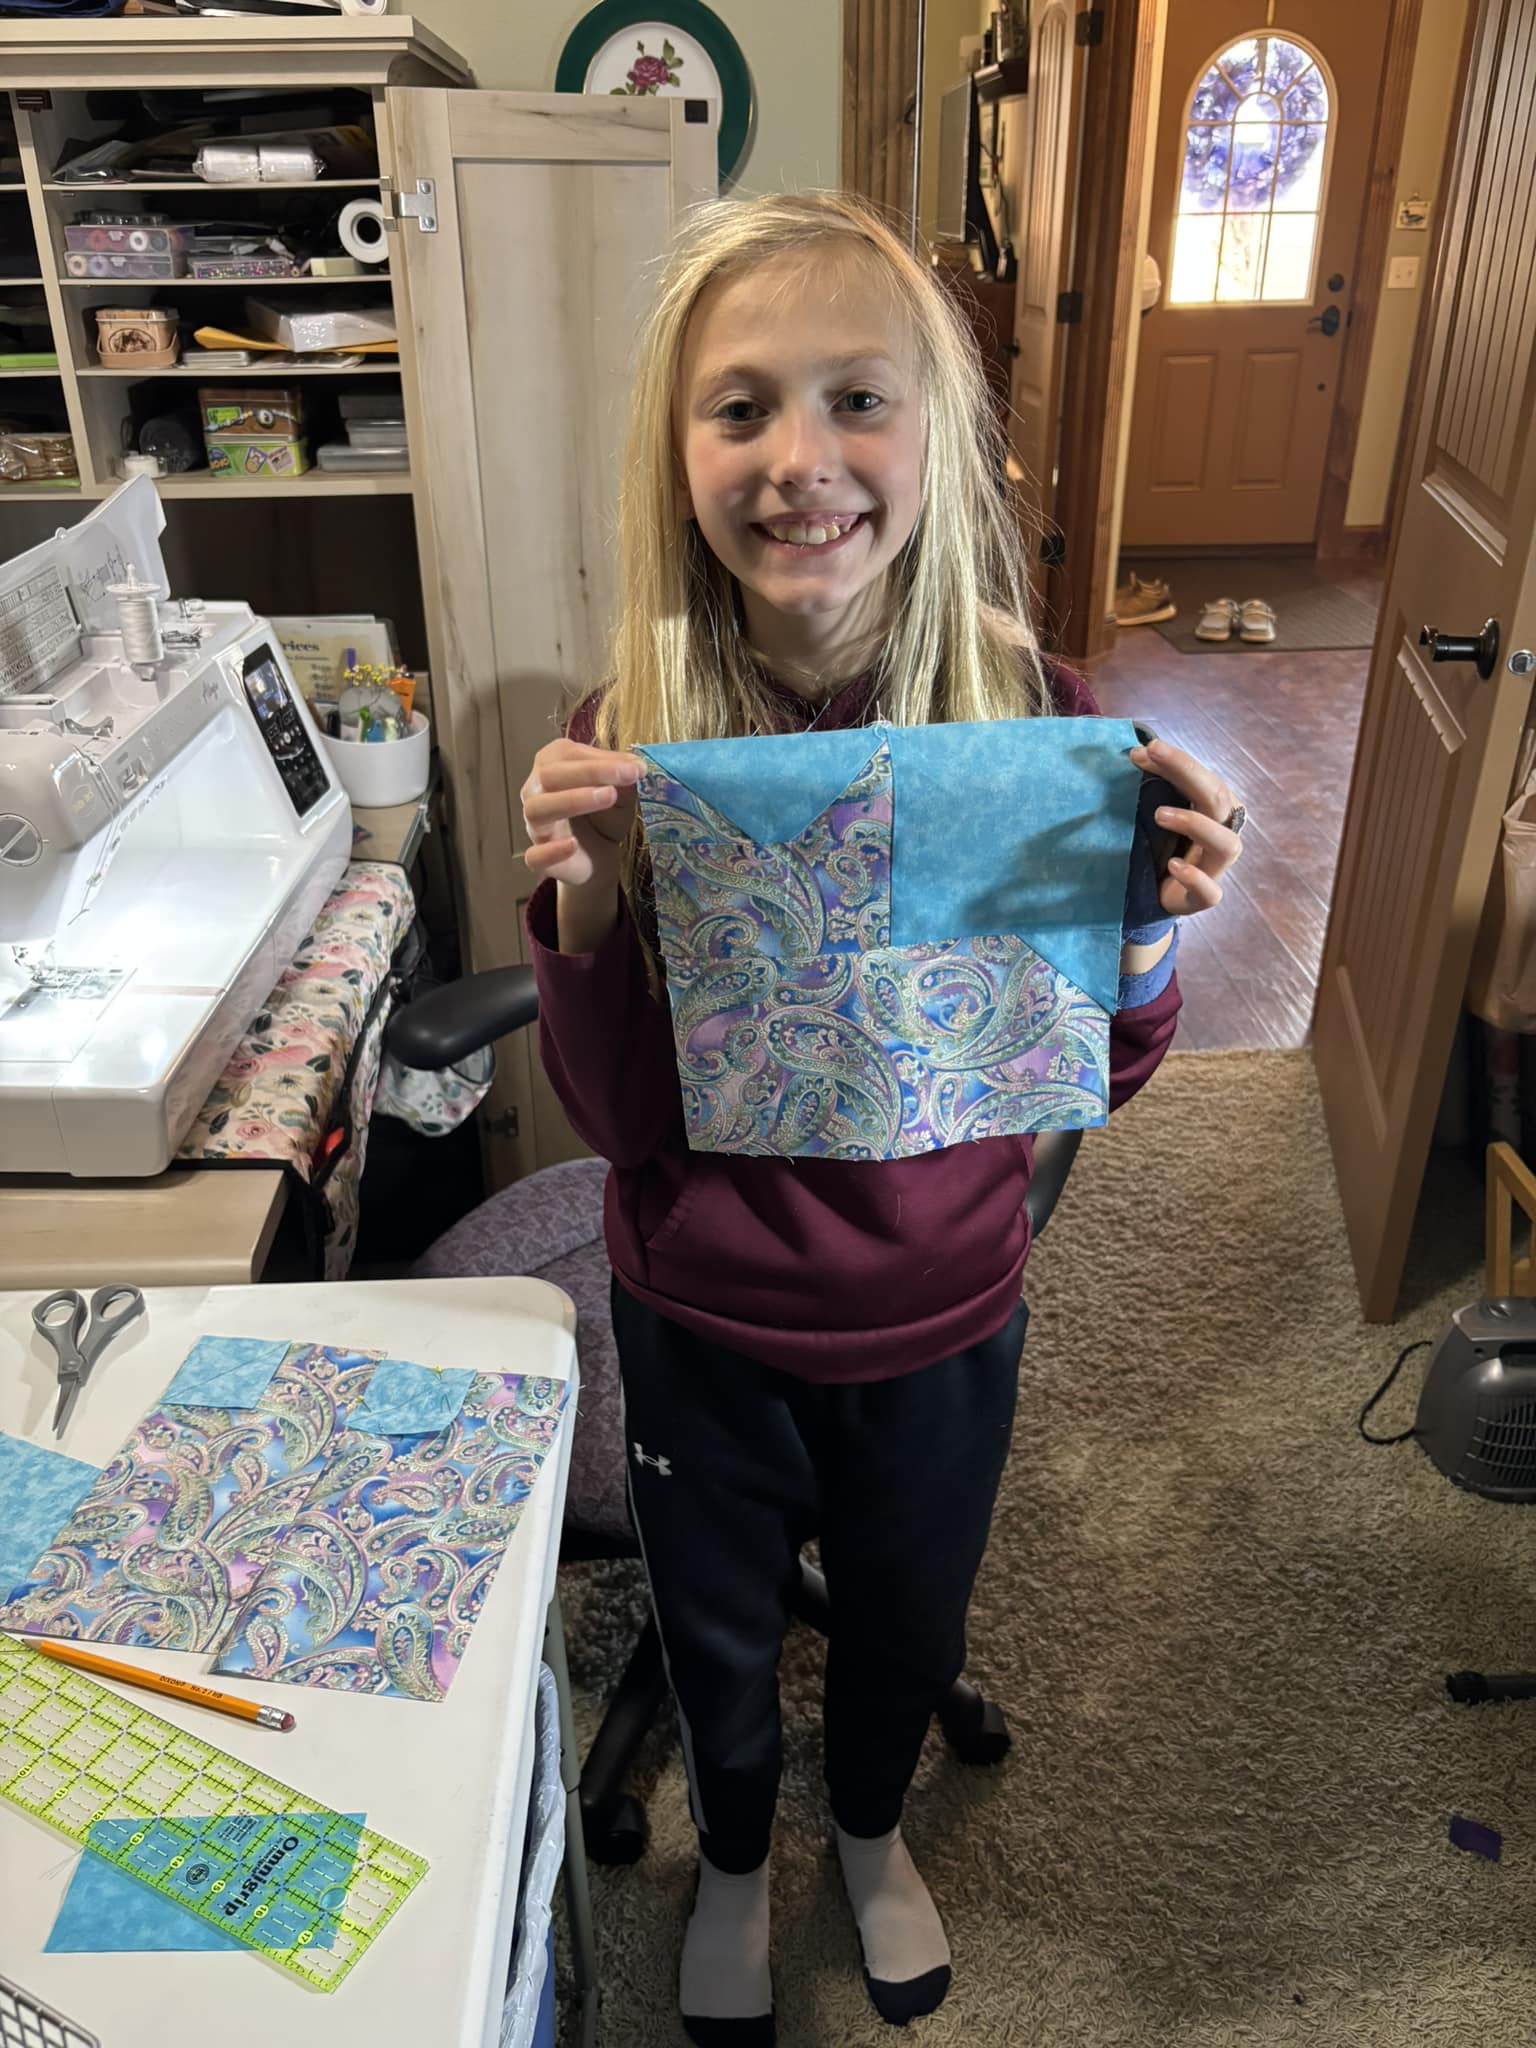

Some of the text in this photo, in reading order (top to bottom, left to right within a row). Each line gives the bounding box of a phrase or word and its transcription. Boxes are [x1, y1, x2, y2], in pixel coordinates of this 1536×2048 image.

[281, 640, 320, 651] rices
[19, 1766, 31, 1776] 10
[56, 1789, 66, 1798] 11
[93, 1811, 105, 1820] 12
[132, 1834, 143, 1843] 13
[172, 1858, 184, 1868] 14
[223, 1836, 299, 1917] Omnigrip
[212, 1881, 224, 1892] 15
[255, 1906, 268, 1917] 16
[300, 1932, 312, 1943] 17
